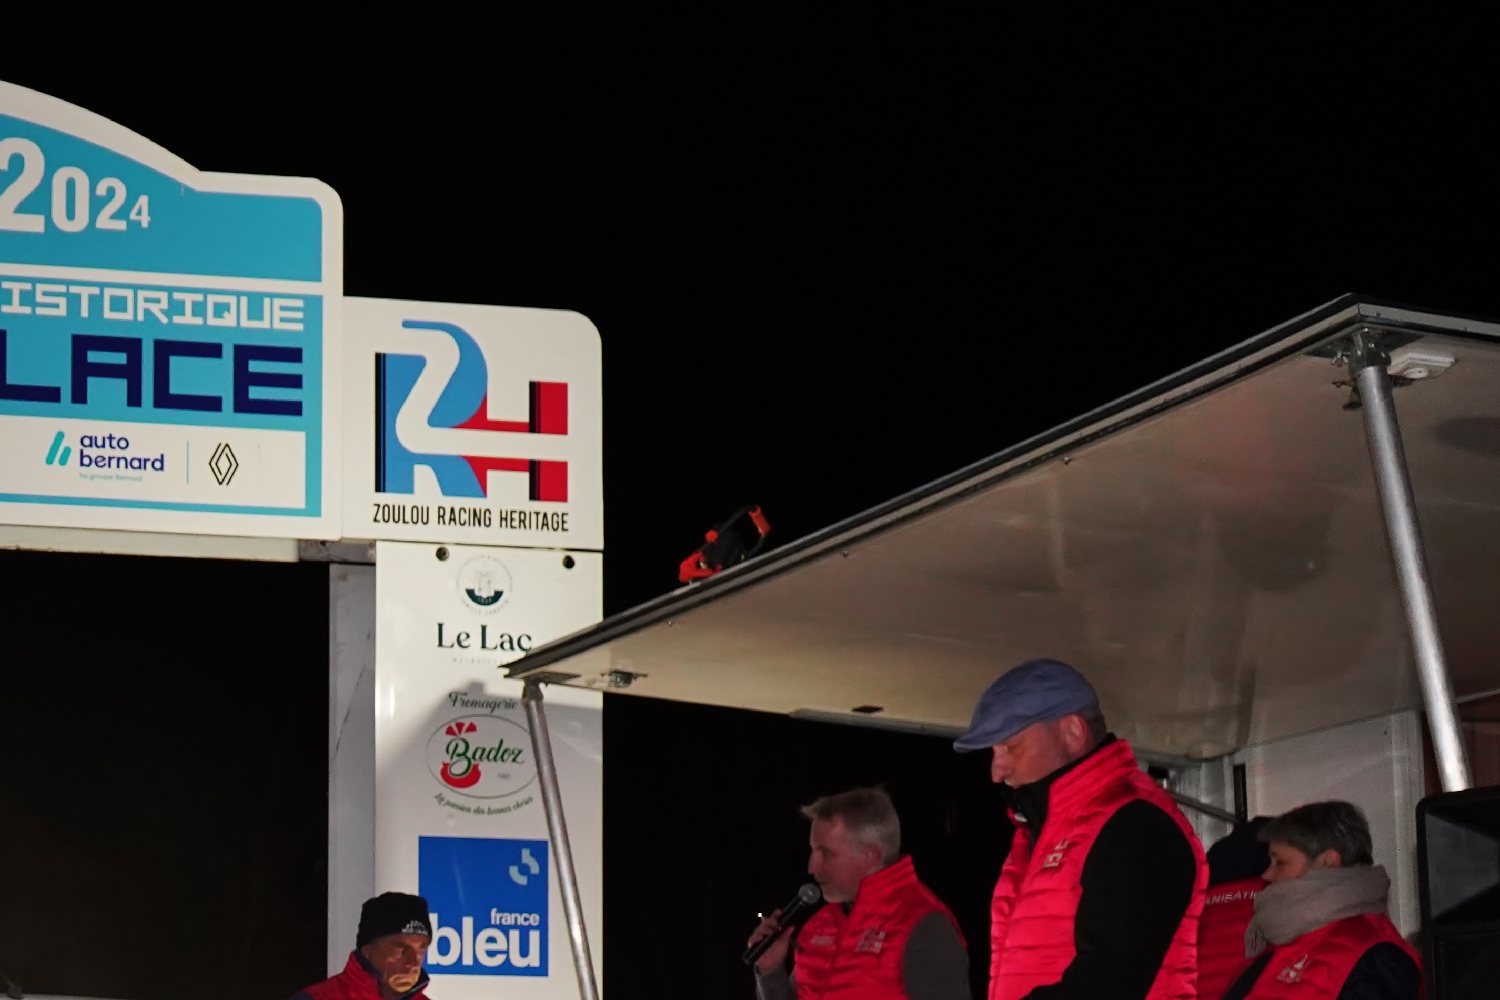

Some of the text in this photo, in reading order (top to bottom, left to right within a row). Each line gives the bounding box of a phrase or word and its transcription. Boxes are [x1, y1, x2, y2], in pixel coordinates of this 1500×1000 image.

[80, 433, 130, 450] auto
[79, 449, 164, 471] bernard
[373, 504, 569, 532] ZOULOU RACING HERITAGE
[437, 622, 532, 651] Le Lac
[448, 691, 517, 713] Fromagerie
[446, 737, 525, 777] Badoz
[490, 908, 540, 926] france
[427, 913, 540, 968] bleu
